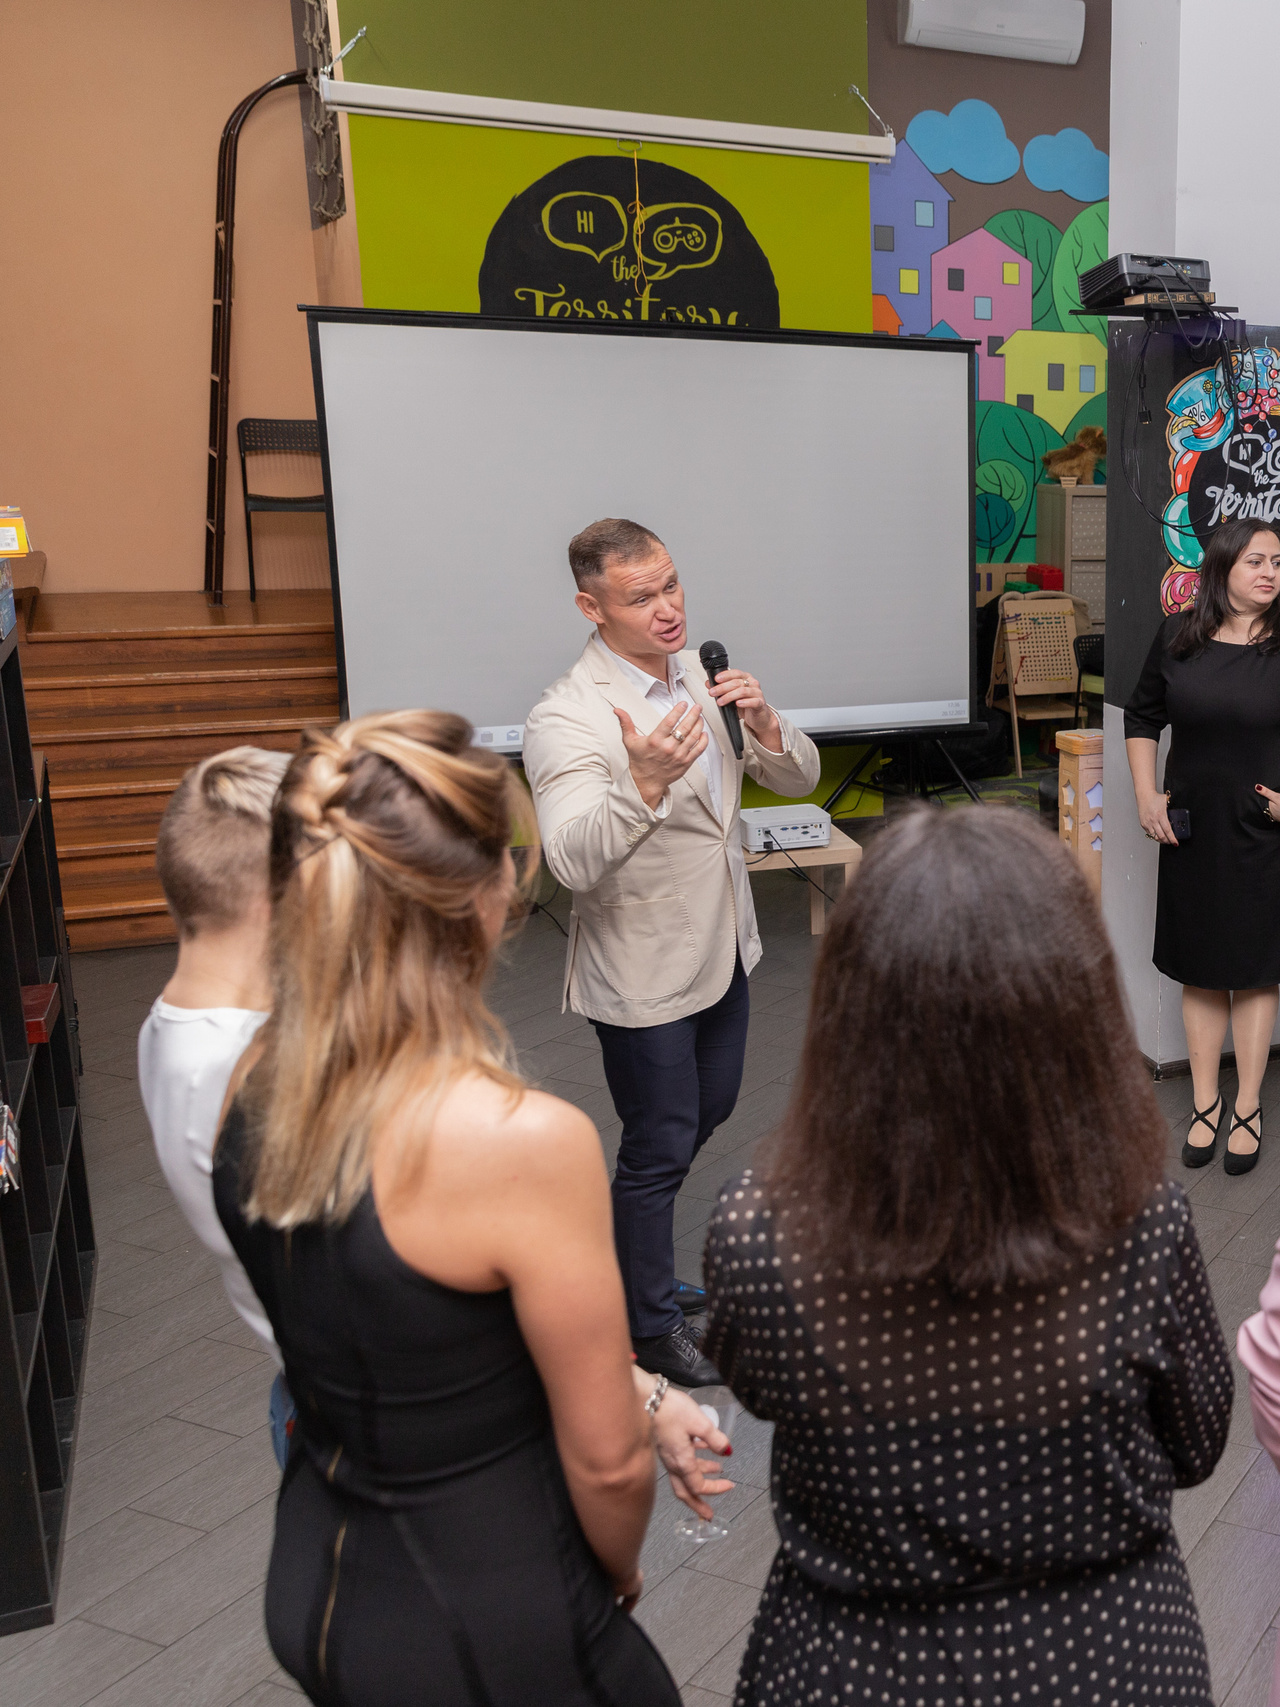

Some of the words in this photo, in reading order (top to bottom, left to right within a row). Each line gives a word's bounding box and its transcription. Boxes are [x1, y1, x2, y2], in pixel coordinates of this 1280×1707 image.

[577, 210, 594, 234] HI
[611, 256, 640, 282] the
[1254, 469, 1271, 487] the
